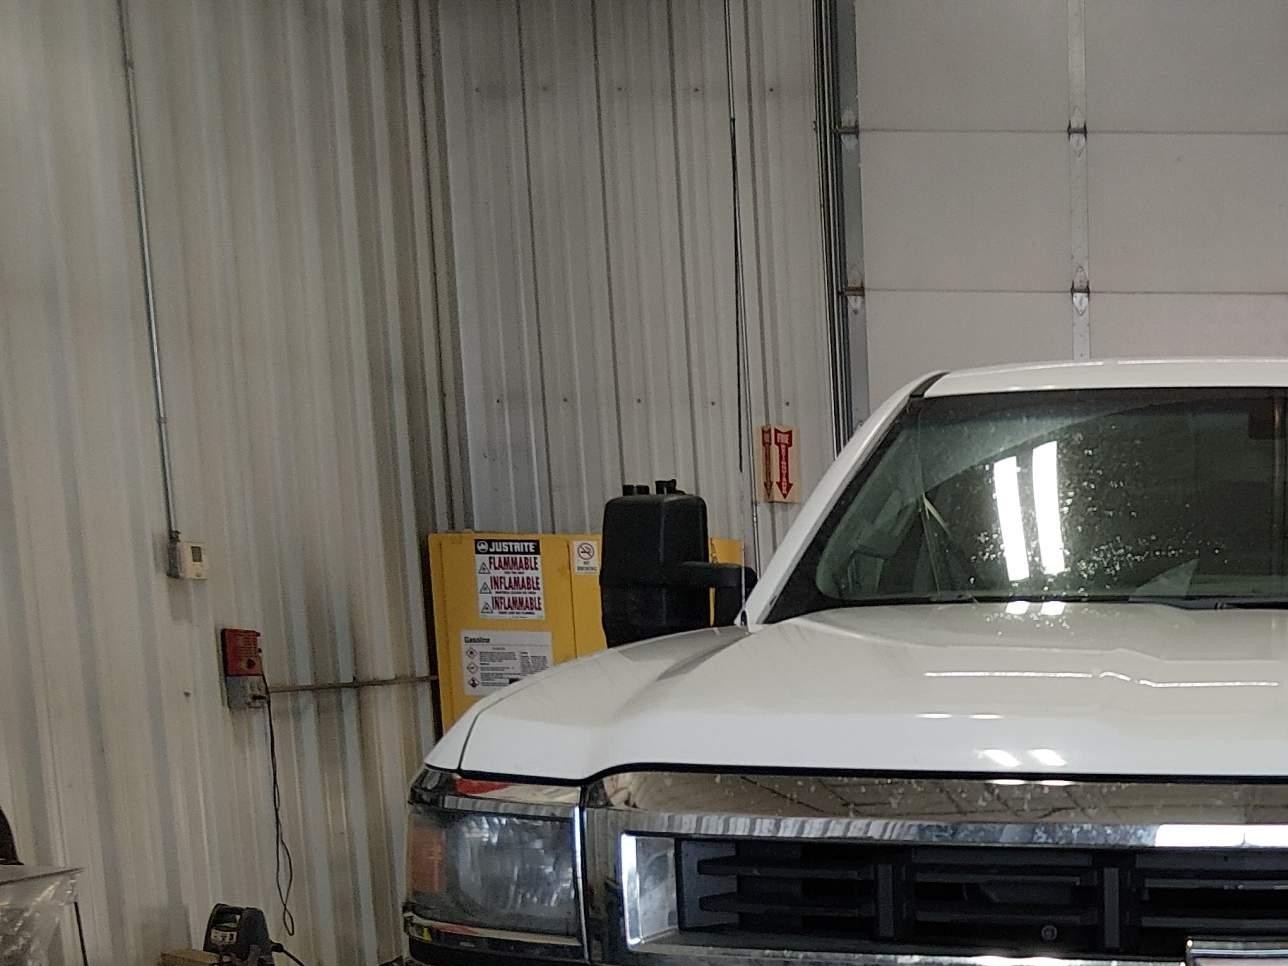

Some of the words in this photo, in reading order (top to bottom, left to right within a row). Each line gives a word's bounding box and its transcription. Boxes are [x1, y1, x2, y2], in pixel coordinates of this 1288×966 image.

[489, 542, 536, 553] JUSTRITE
[488, 556, 539, 571] FLAMMABLE
[490, 576, 541, 591] INFLAMABLE
[492, 596, 542, 611] INFLAMMABLE
